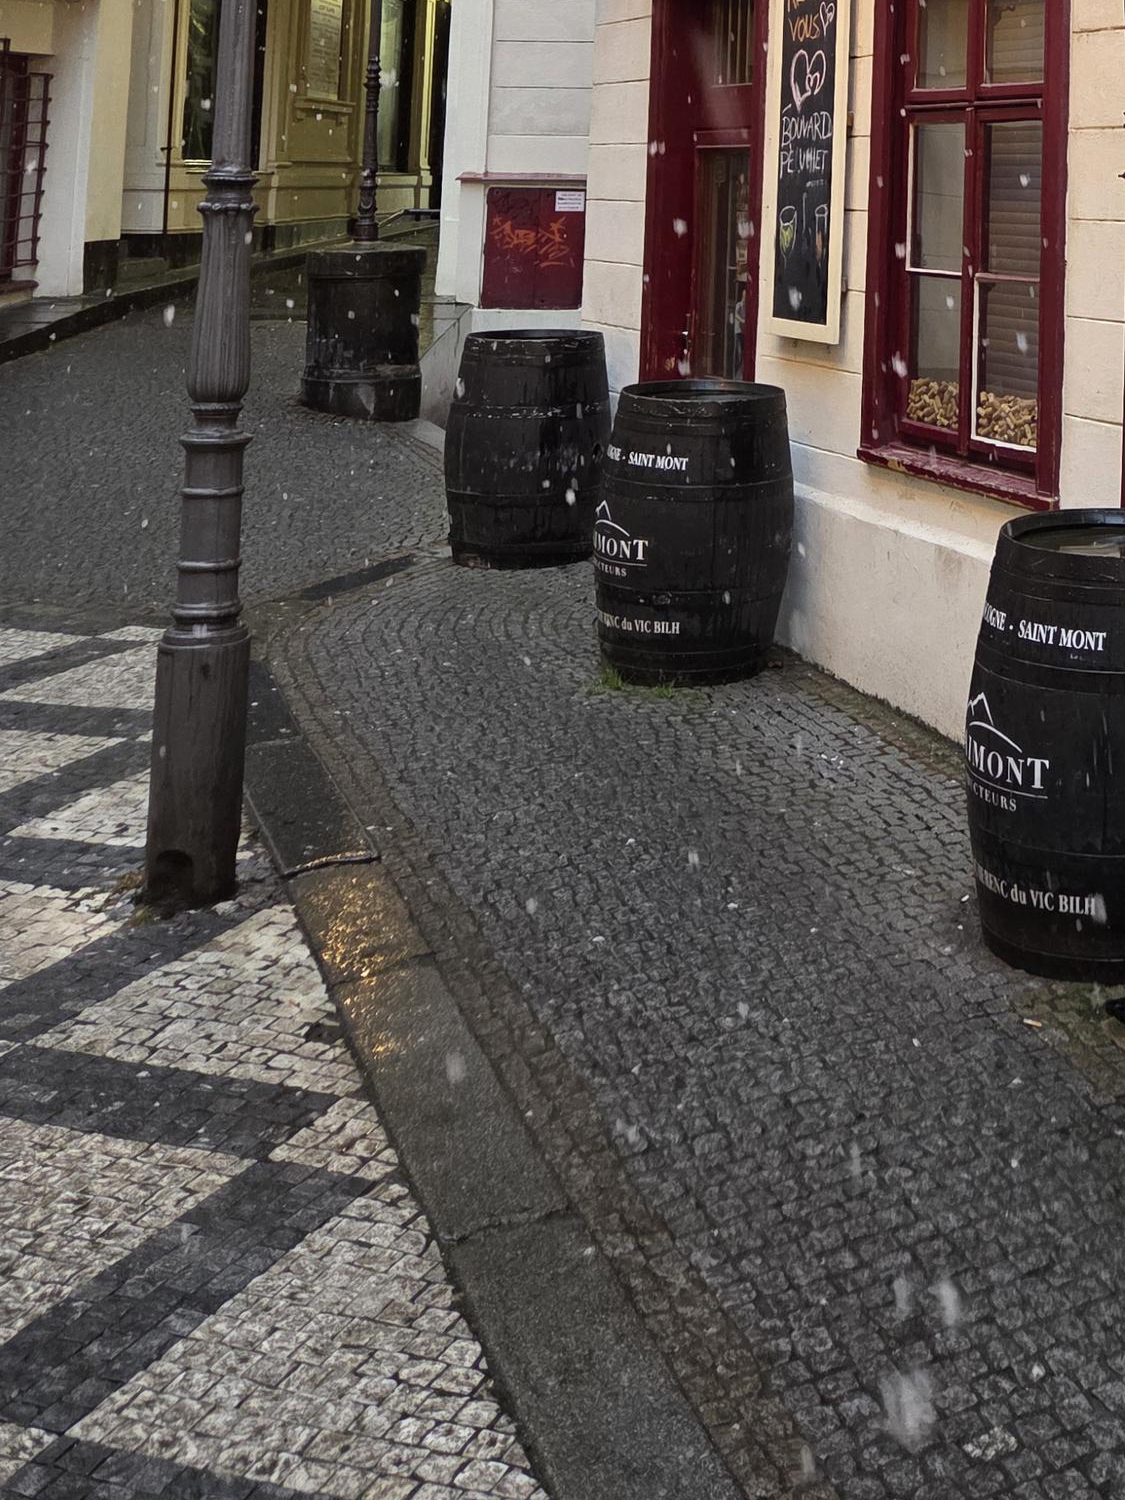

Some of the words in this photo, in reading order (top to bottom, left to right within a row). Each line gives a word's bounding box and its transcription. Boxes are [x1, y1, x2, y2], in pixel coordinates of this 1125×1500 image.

[787, 12, 821, 42] VOUS
[628, 451, 655, 468] SAINT
[655, 455, 689, 471] MONT
[634, 619, 652, 633] VIC
[653, 621, 680, 634] BILH
[1018, 619, 1057, 645] SAINT
[1058, 627, 1107, 652] MONT
[1010, 883, 1027, 905] du
[1029, 889, 1055, 912] VIC
[1058, 894, 1097, 916] BILH
